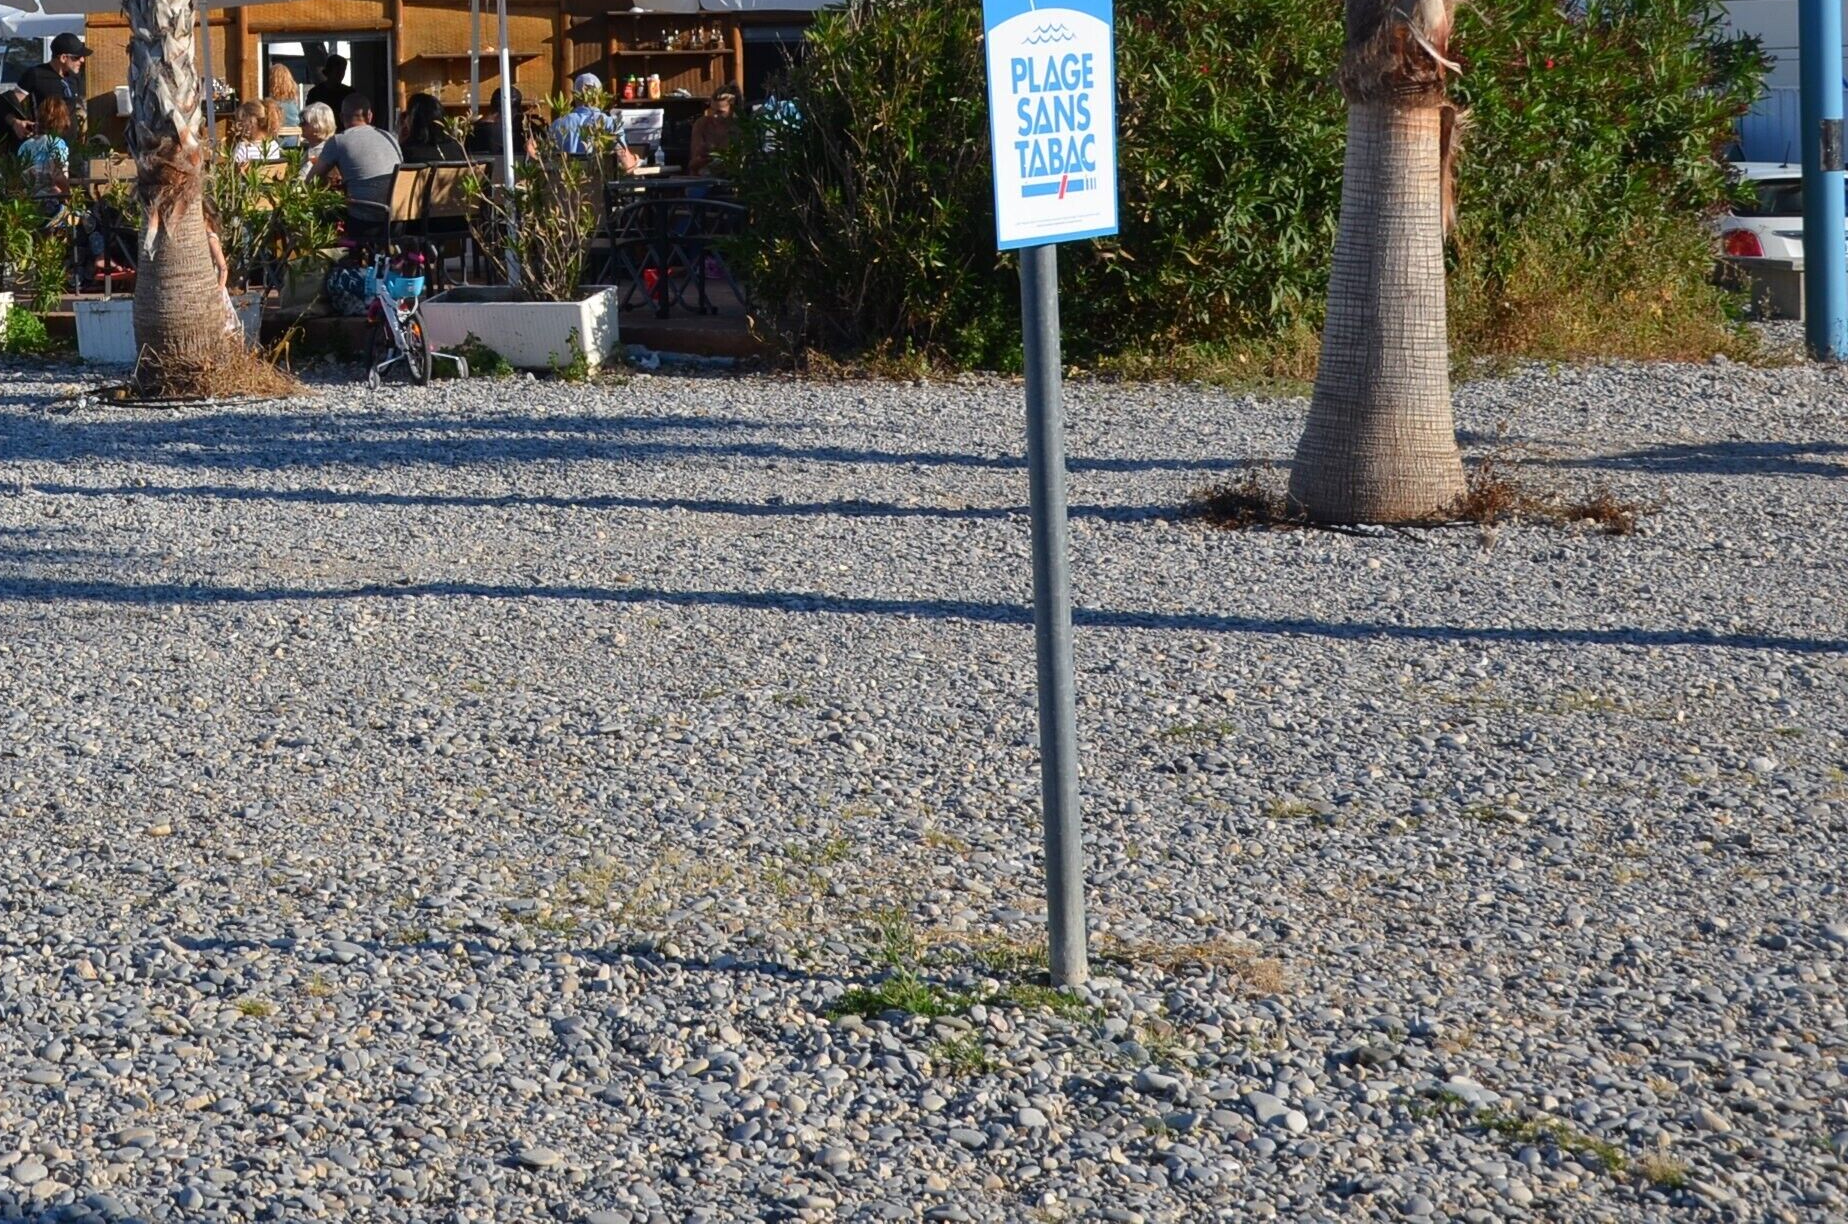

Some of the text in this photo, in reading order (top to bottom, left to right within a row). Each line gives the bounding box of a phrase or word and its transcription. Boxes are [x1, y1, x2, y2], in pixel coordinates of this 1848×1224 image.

[1011, 53, 1094, 94] PLAGE
[1017, 93, 1092, 137] SANS
[1014, 134, 1096, 178] TABAC
